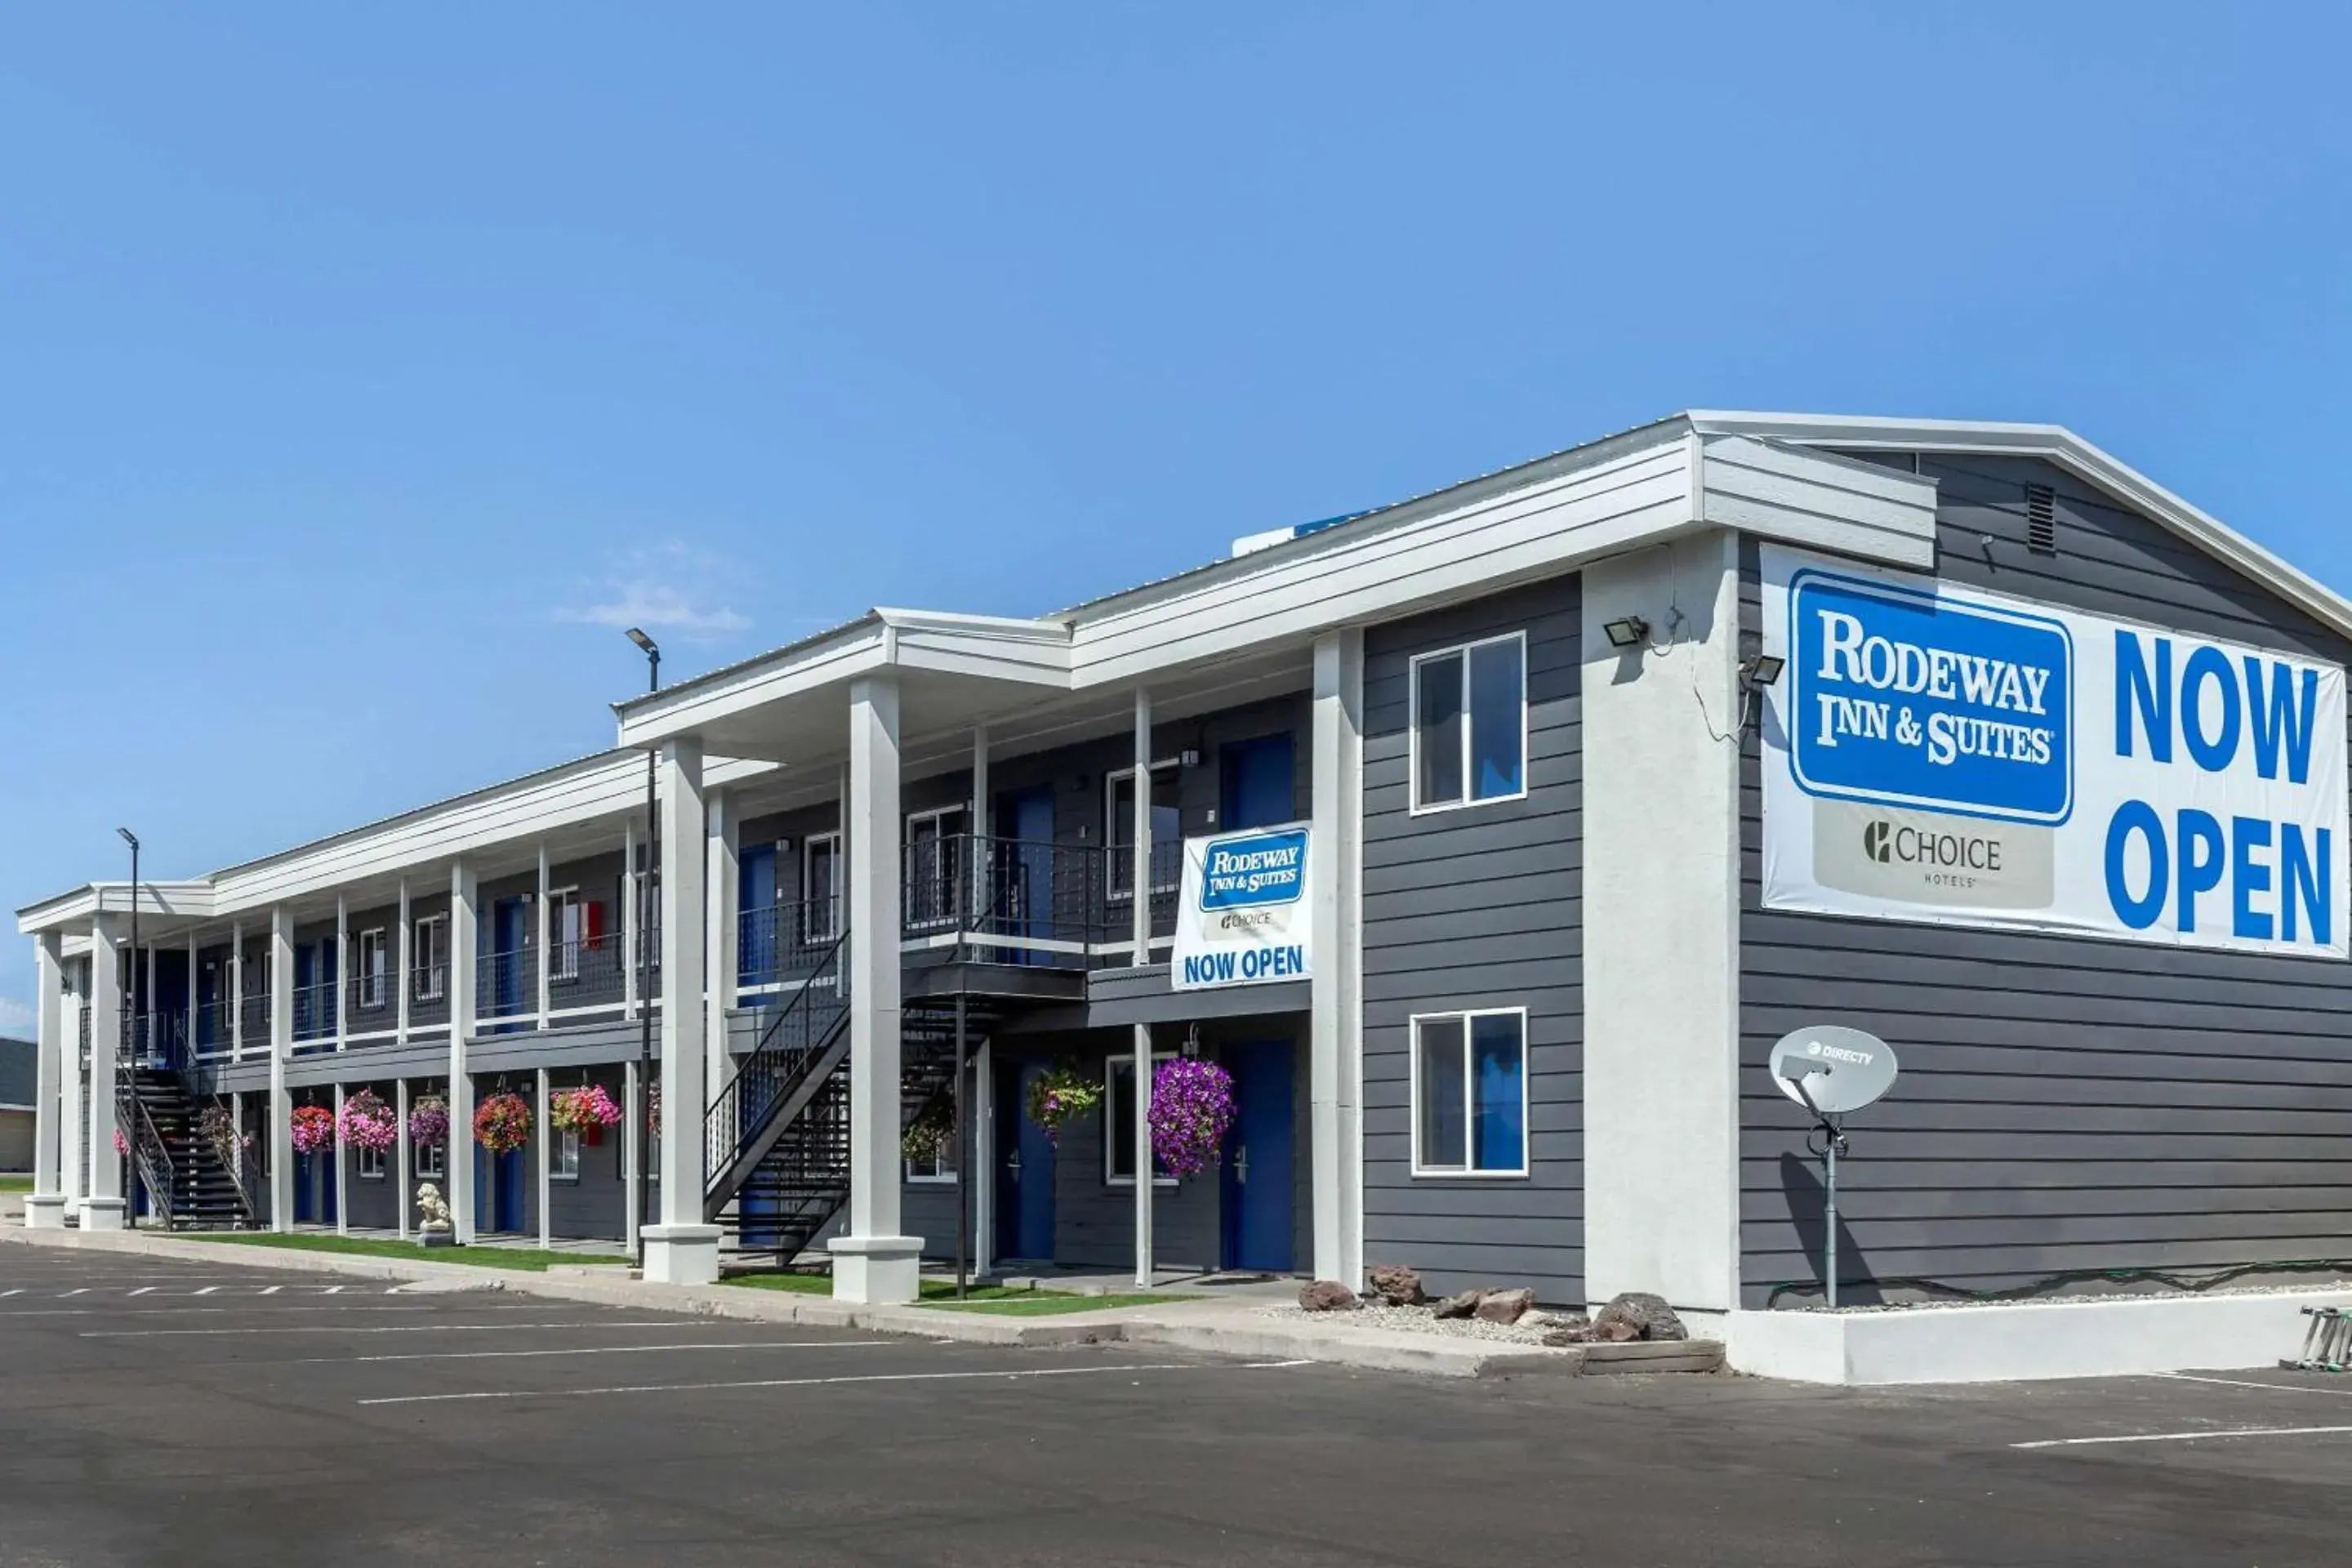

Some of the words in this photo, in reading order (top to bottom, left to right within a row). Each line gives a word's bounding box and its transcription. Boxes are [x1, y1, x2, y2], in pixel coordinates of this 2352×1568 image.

[1817, 609, 2050, 715] RODEWAY
[2114, 628, 2319, 785] NOW
[1817, 693, 1891, 747] INN
[1895, 707, 1922, 746] &
[1928, 712, 2051, 766] SUITES
[1211, 847, 1298, 875] RODEWAY
[1896, 826, 2002, 871] CHOICE
[1209, 877, 1235, 896] INN
[1236, 875, 1246, 889] &
[1248, 869, 1296, 892] SUITES
[1924, 874, 1974, 888] HOTELS
[2105, 799, 2332, 946] OPEN
[1232, 912, 1271, 928] CHOICE
[1185, 952, 1236, 982] NOW
[1242, 945, 1303, 978] OPEN
[1822, 1045, 1873, 1065] DIRECTV
